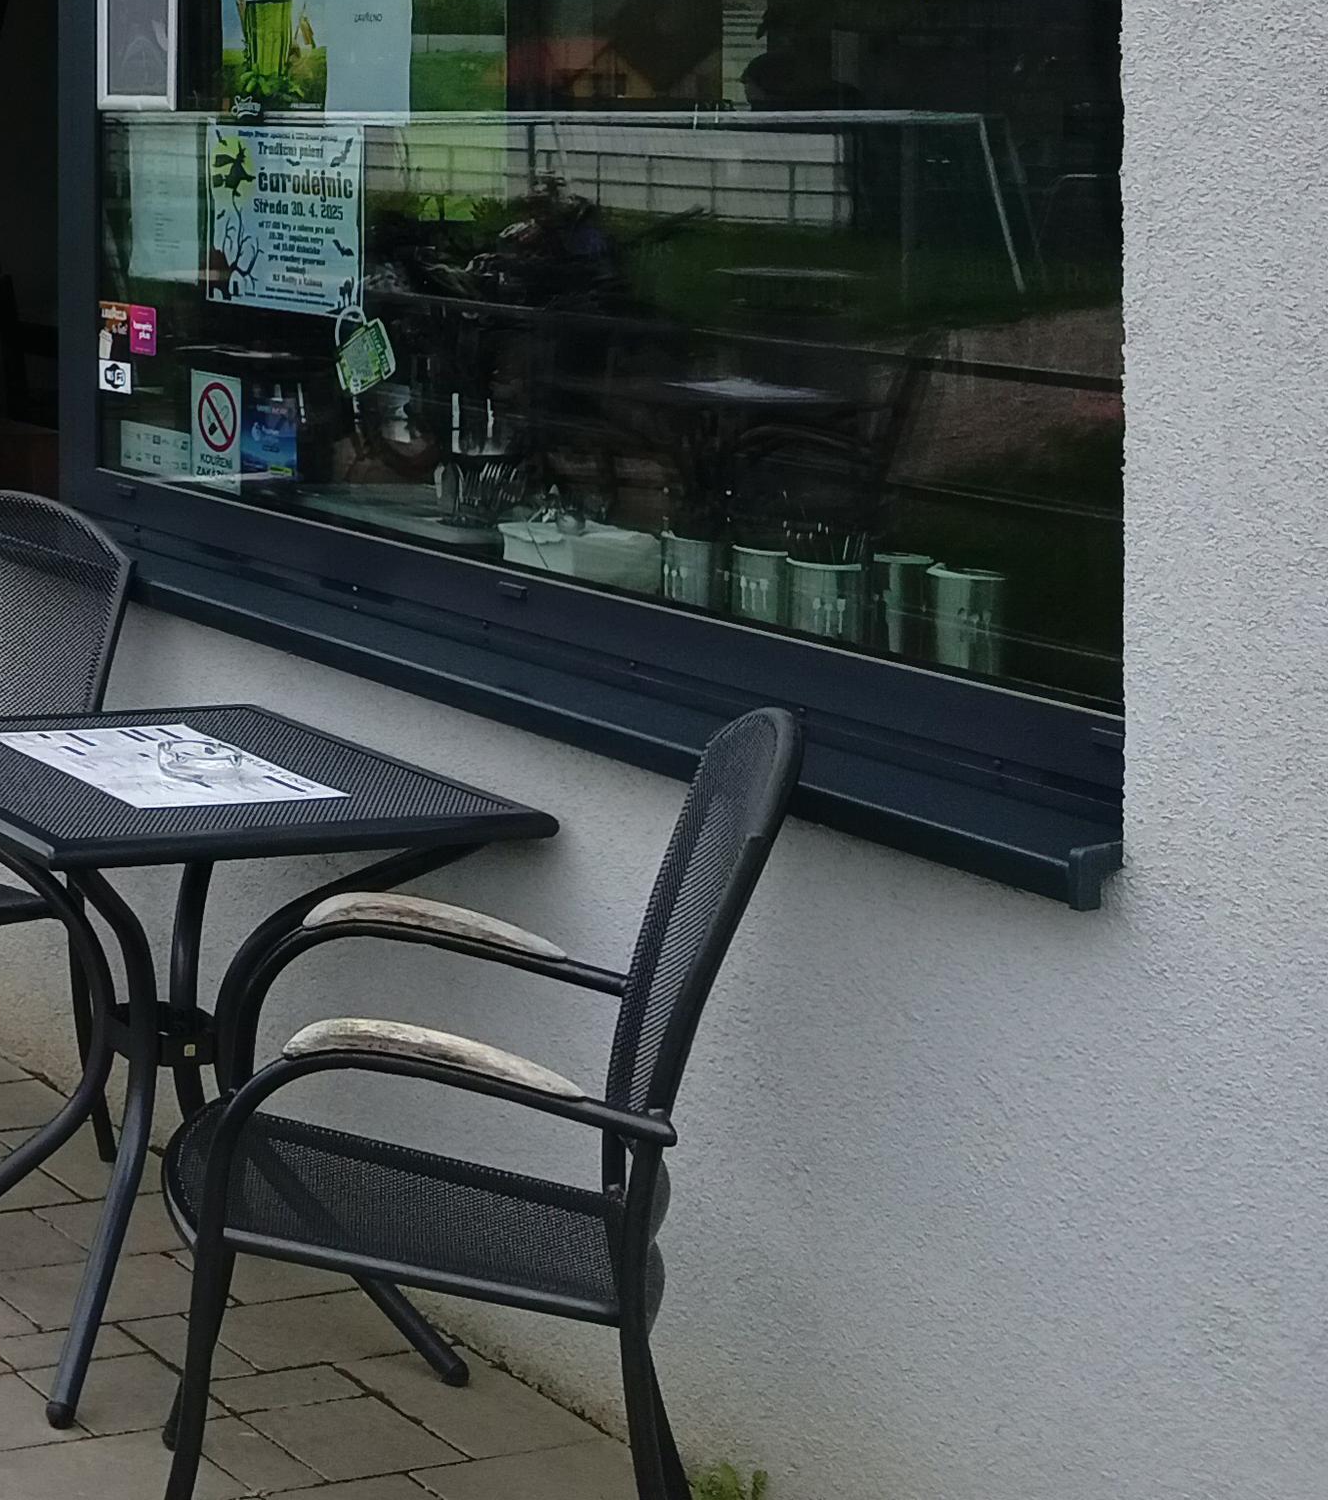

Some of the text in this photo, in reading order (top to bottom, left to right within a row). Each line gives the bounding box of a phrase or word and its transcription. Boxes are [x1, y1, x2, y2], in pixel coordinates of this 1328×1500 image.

[258, 167, 353, 202] čarodějnic
[253, 198, 344, 221] Středa 30. 4. 2025
